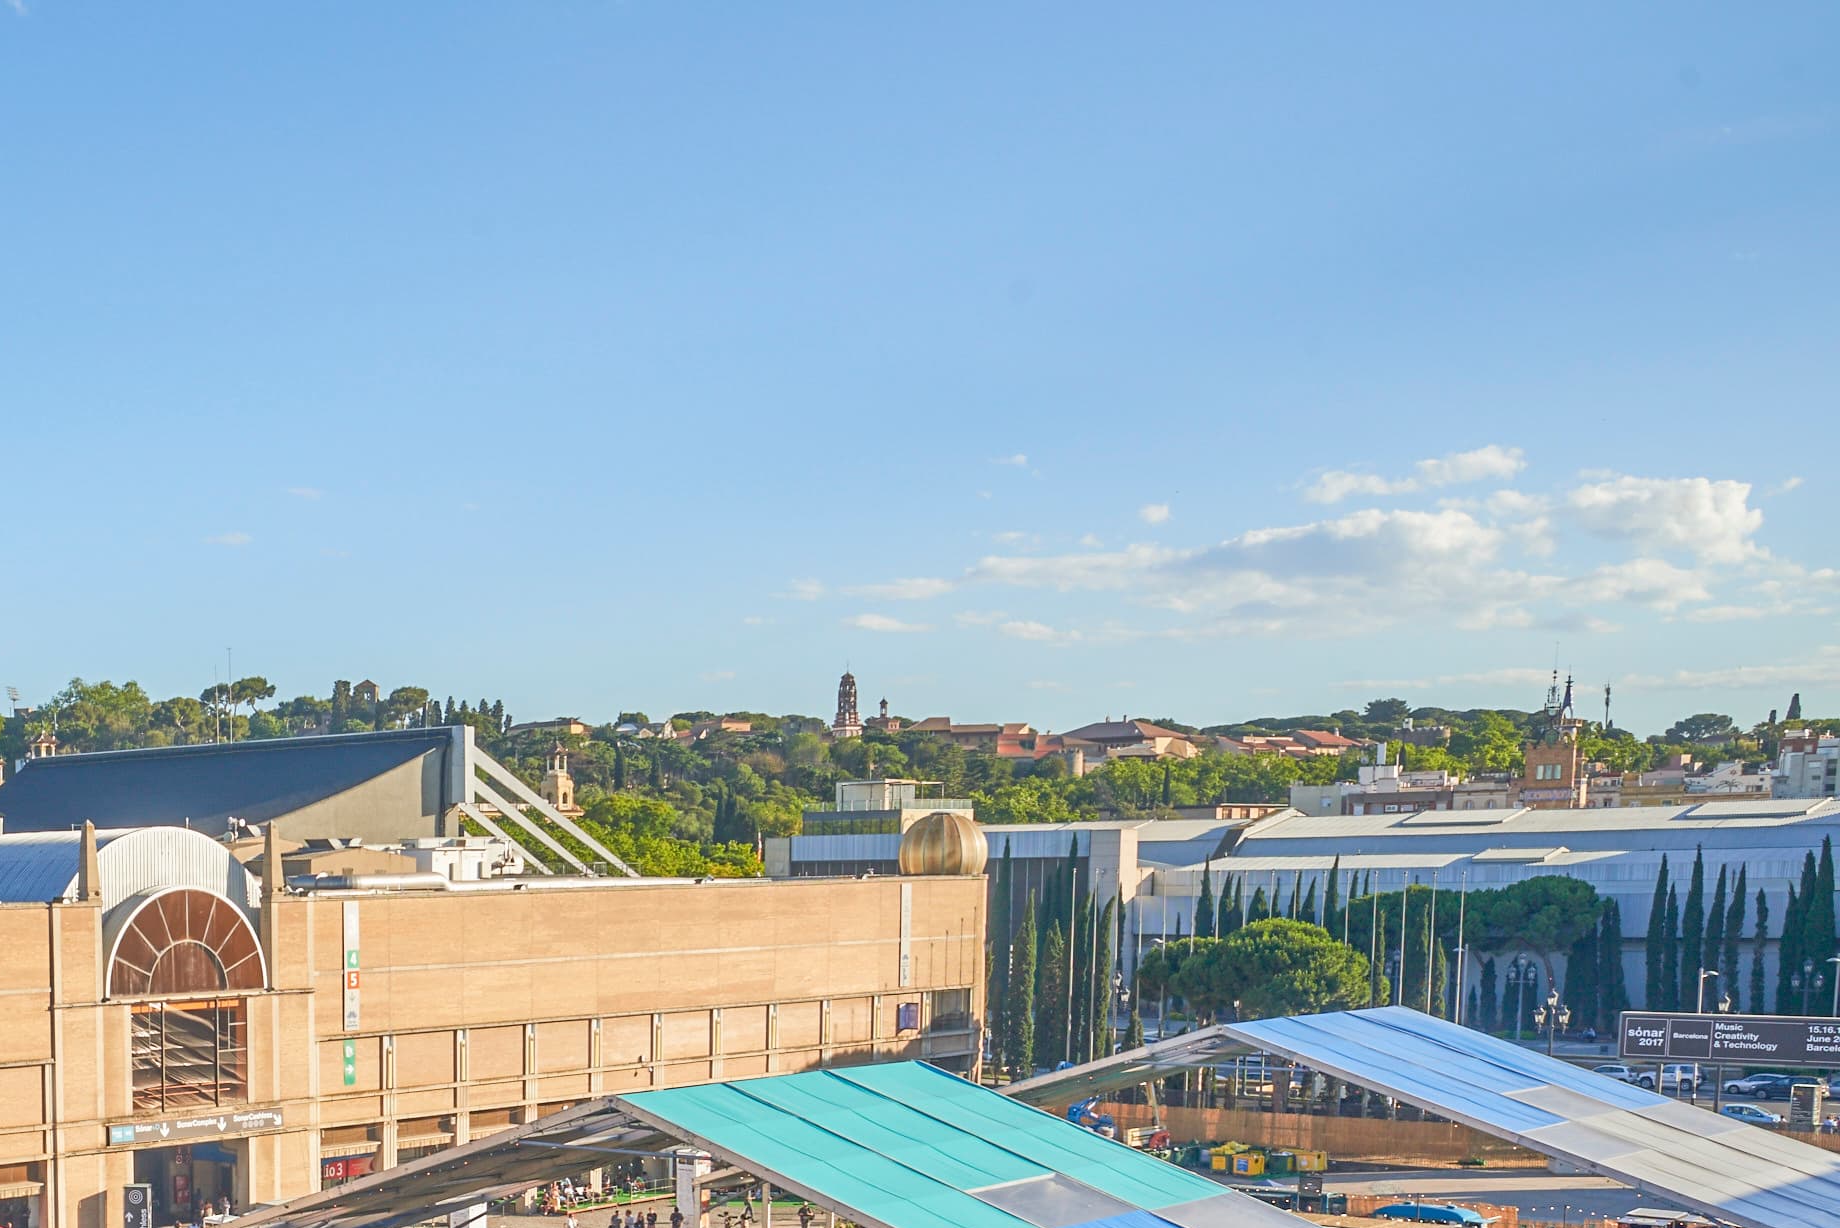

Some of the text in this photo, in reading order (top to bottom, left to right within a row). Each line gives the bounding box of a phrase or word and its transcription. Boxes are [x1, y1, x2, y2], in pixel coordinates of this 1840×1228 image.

[349, 952, 357, 966] 4
[350, 974, 358, 987] 5
[1628, 1027, 1665, 1037] sónar
[1715, 1023, 1743, 1031] Music
[1673, 1032, 1708, 1040] Barcelona
[1714, 1031, 1759, 1042] Creativity
[1807, 1035, 1830, 1043] June
[1723, 1041, 1778, 1051] Technology
[336, 1162, 343, 1176] 3
